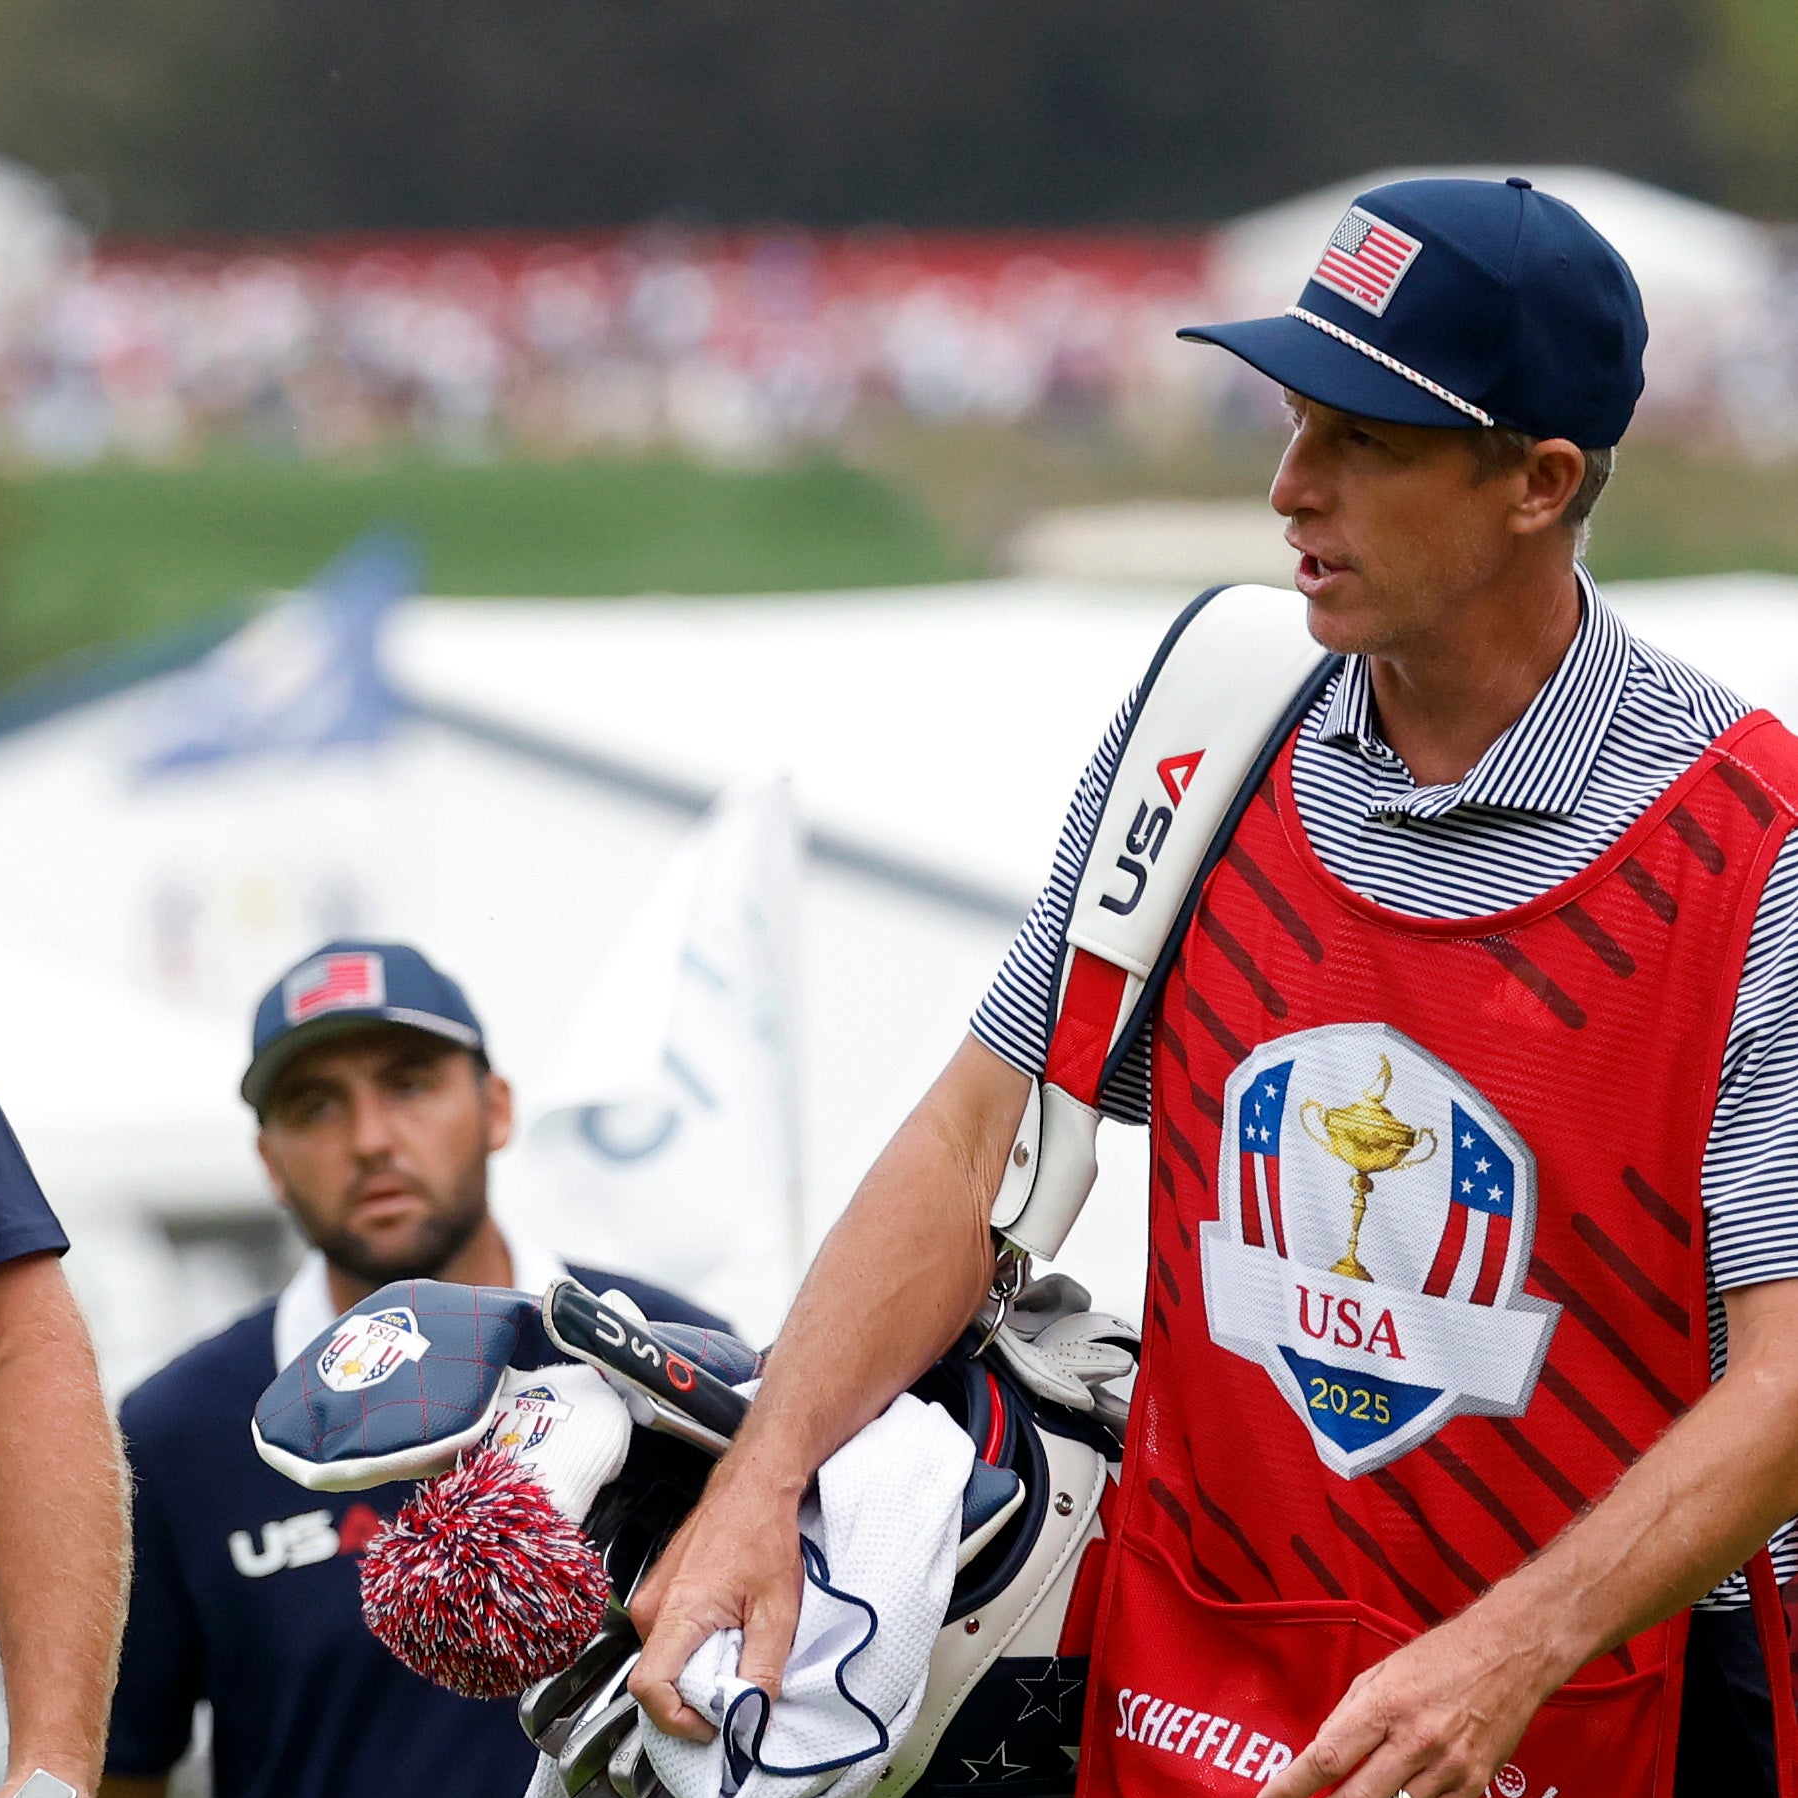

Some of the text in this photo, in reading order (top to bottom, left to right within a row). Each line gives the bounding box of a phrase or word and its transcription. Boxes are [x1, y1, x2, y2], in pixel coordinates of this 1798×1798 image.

[1098, 748, 1207, 916] USA
[366, 1323, 400, 1342] USA
[1296, 1284, 1407, 1361] USA
[515, 1399, 546, 1412] USA
[1309, 1377, 1392, 1425] 2025
[226, 1503, 386, 1579] USA
[1115, 1688, 1293, 1782] SCHEFFLER
